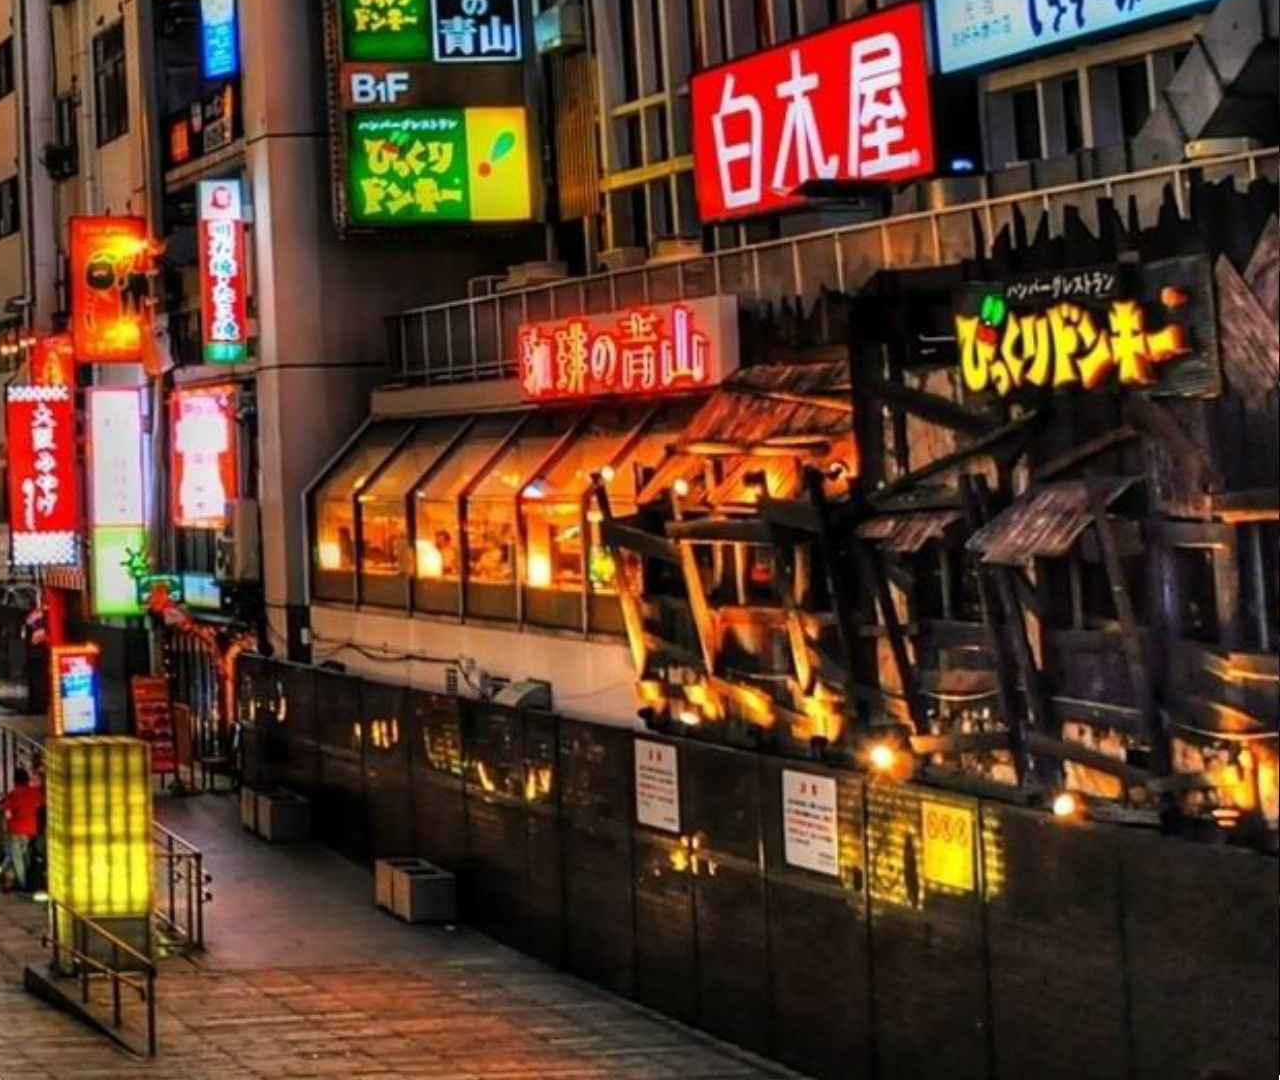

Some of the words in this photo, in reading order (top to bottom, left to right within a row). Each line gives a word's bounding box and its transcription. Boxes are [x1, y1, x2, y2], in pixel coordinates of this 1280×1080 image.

[353, 8, 418, 32] ドンキー
[439, 14, 514, 55] 青山
[349, 71, 410, 104] B1F
[711, 30, 921, 210] 白木屋
[363, 138, 454, 178] びっくり
[359, 177, 463, 216] ドンキー
[955, 300, 1192, 397] びっくりドンキー
